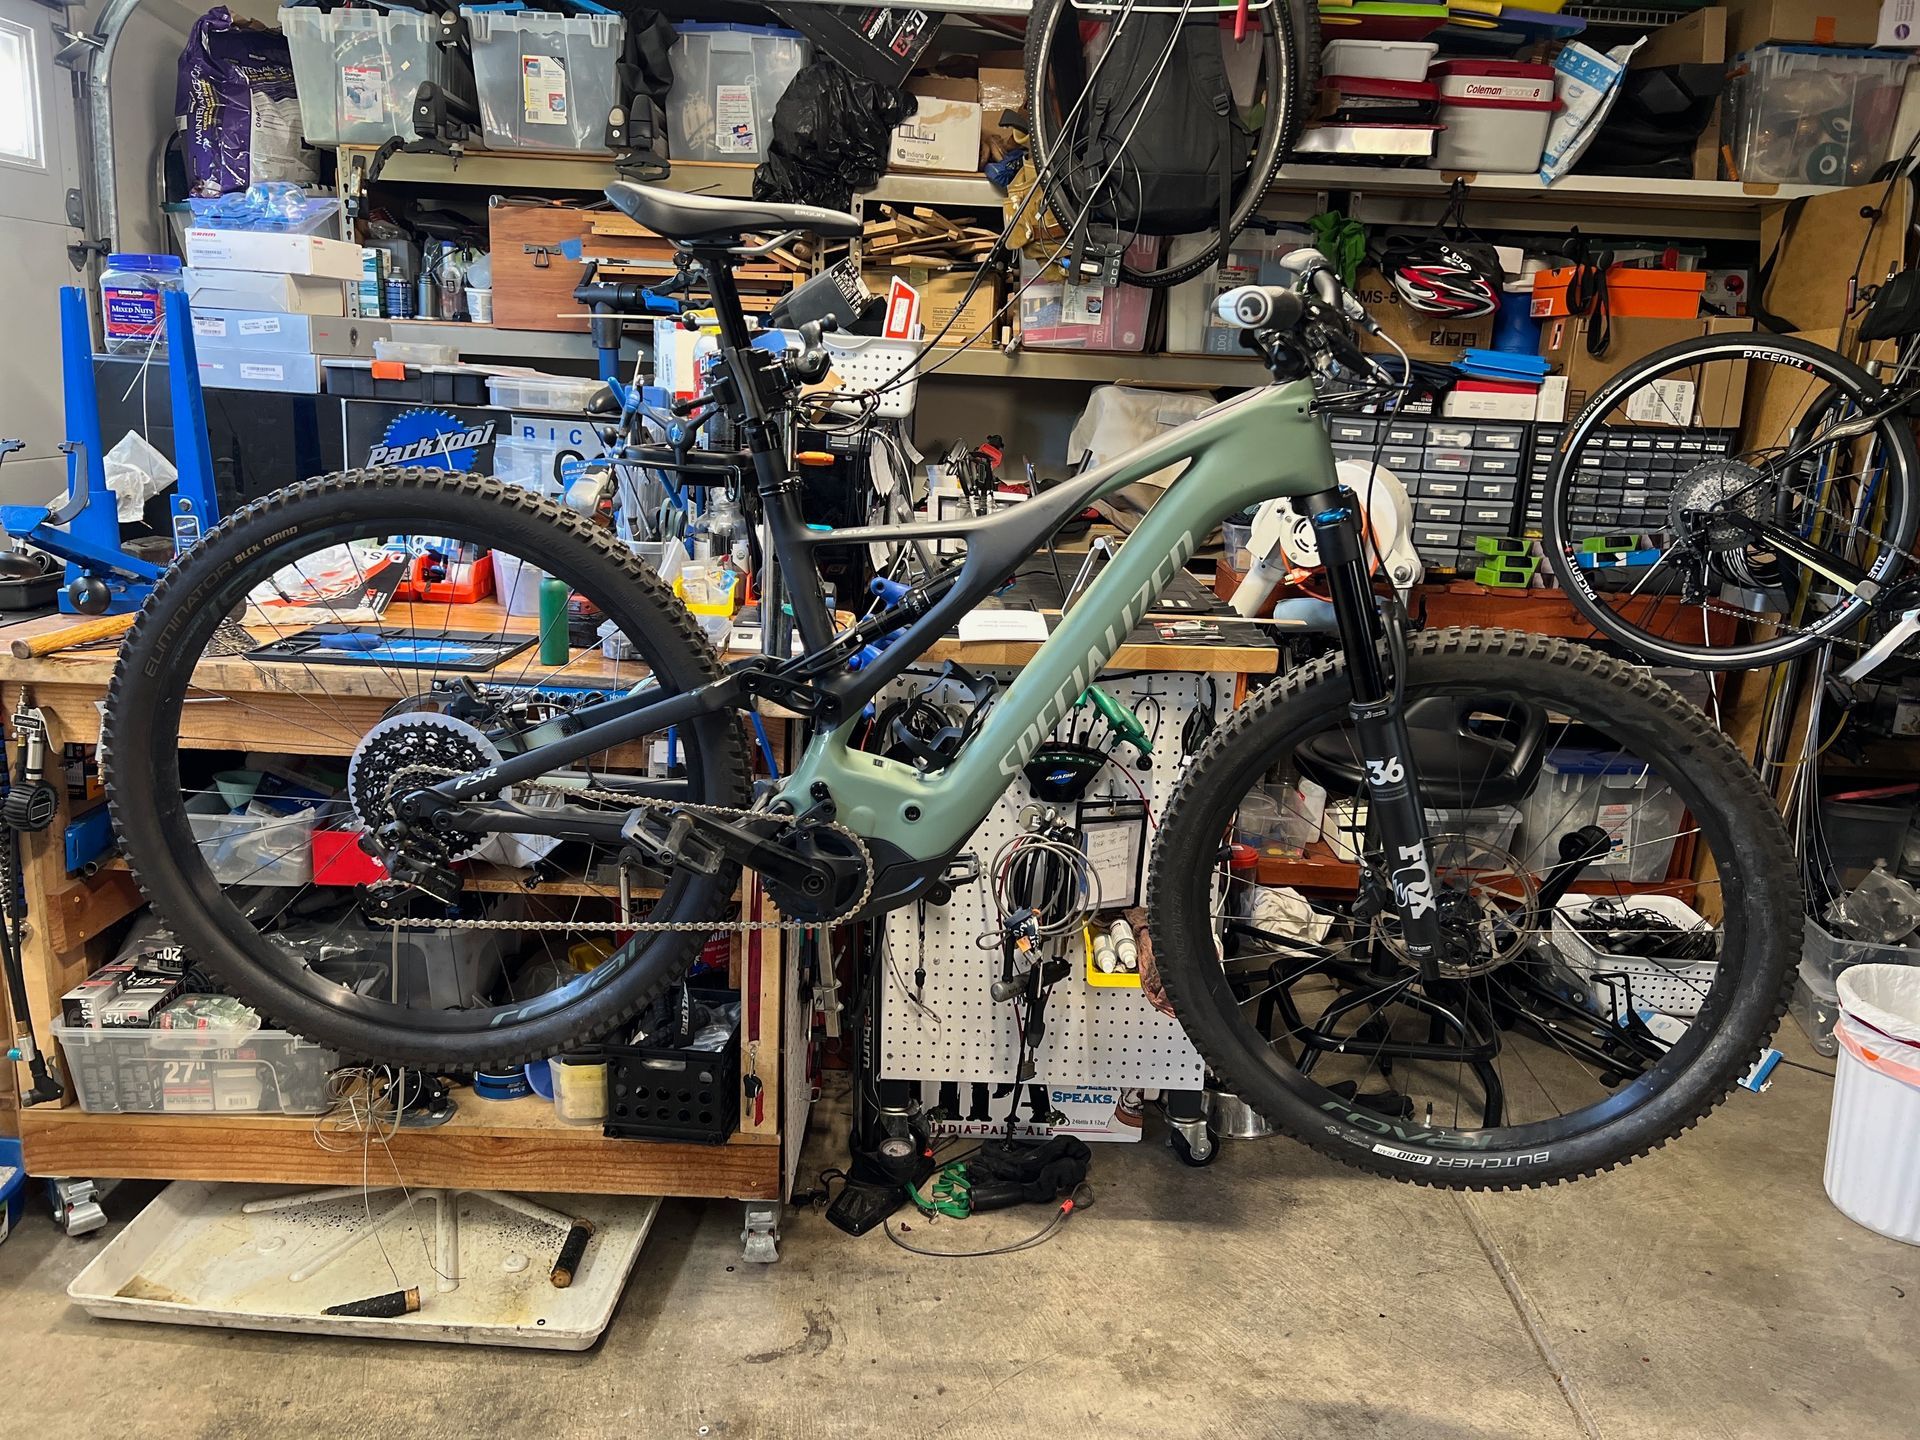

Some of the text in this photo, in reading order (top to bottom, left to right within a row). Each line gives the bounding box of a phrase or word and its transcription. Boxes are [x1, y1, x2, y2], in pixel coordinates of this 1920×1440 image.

[1466, 84, 1502, 95] Coleman
[1533, 88, 1540, 98] 8
[111, 305, 154, 314] MIXED NUTS
[1743, 349, 1804, 368] PACENTI
[234, 543, 262, 565] BLCK
[1564, 554, 1597, 602] PACENTI
[143, 559, 234, 679] ELIMINATOR
[998, 529, 1195, 777] SPECIALIZED
[455, 767, 499, 791] FSR
[1365, 756, 1405, 786] 36
[1391, 838, 1437, 920] FOX
[163, 1061, 207, 1083] 27"
[1051, 1091, 1117, 1105] SPEAKS.
[931, 1121, 973, 1134] INDIA
[1024, 1124, 1054, 1137] ALE
[1396, 1150, 1433, 1166] GRID
[1436, 1151, 1551, 1169] BUTCHER
